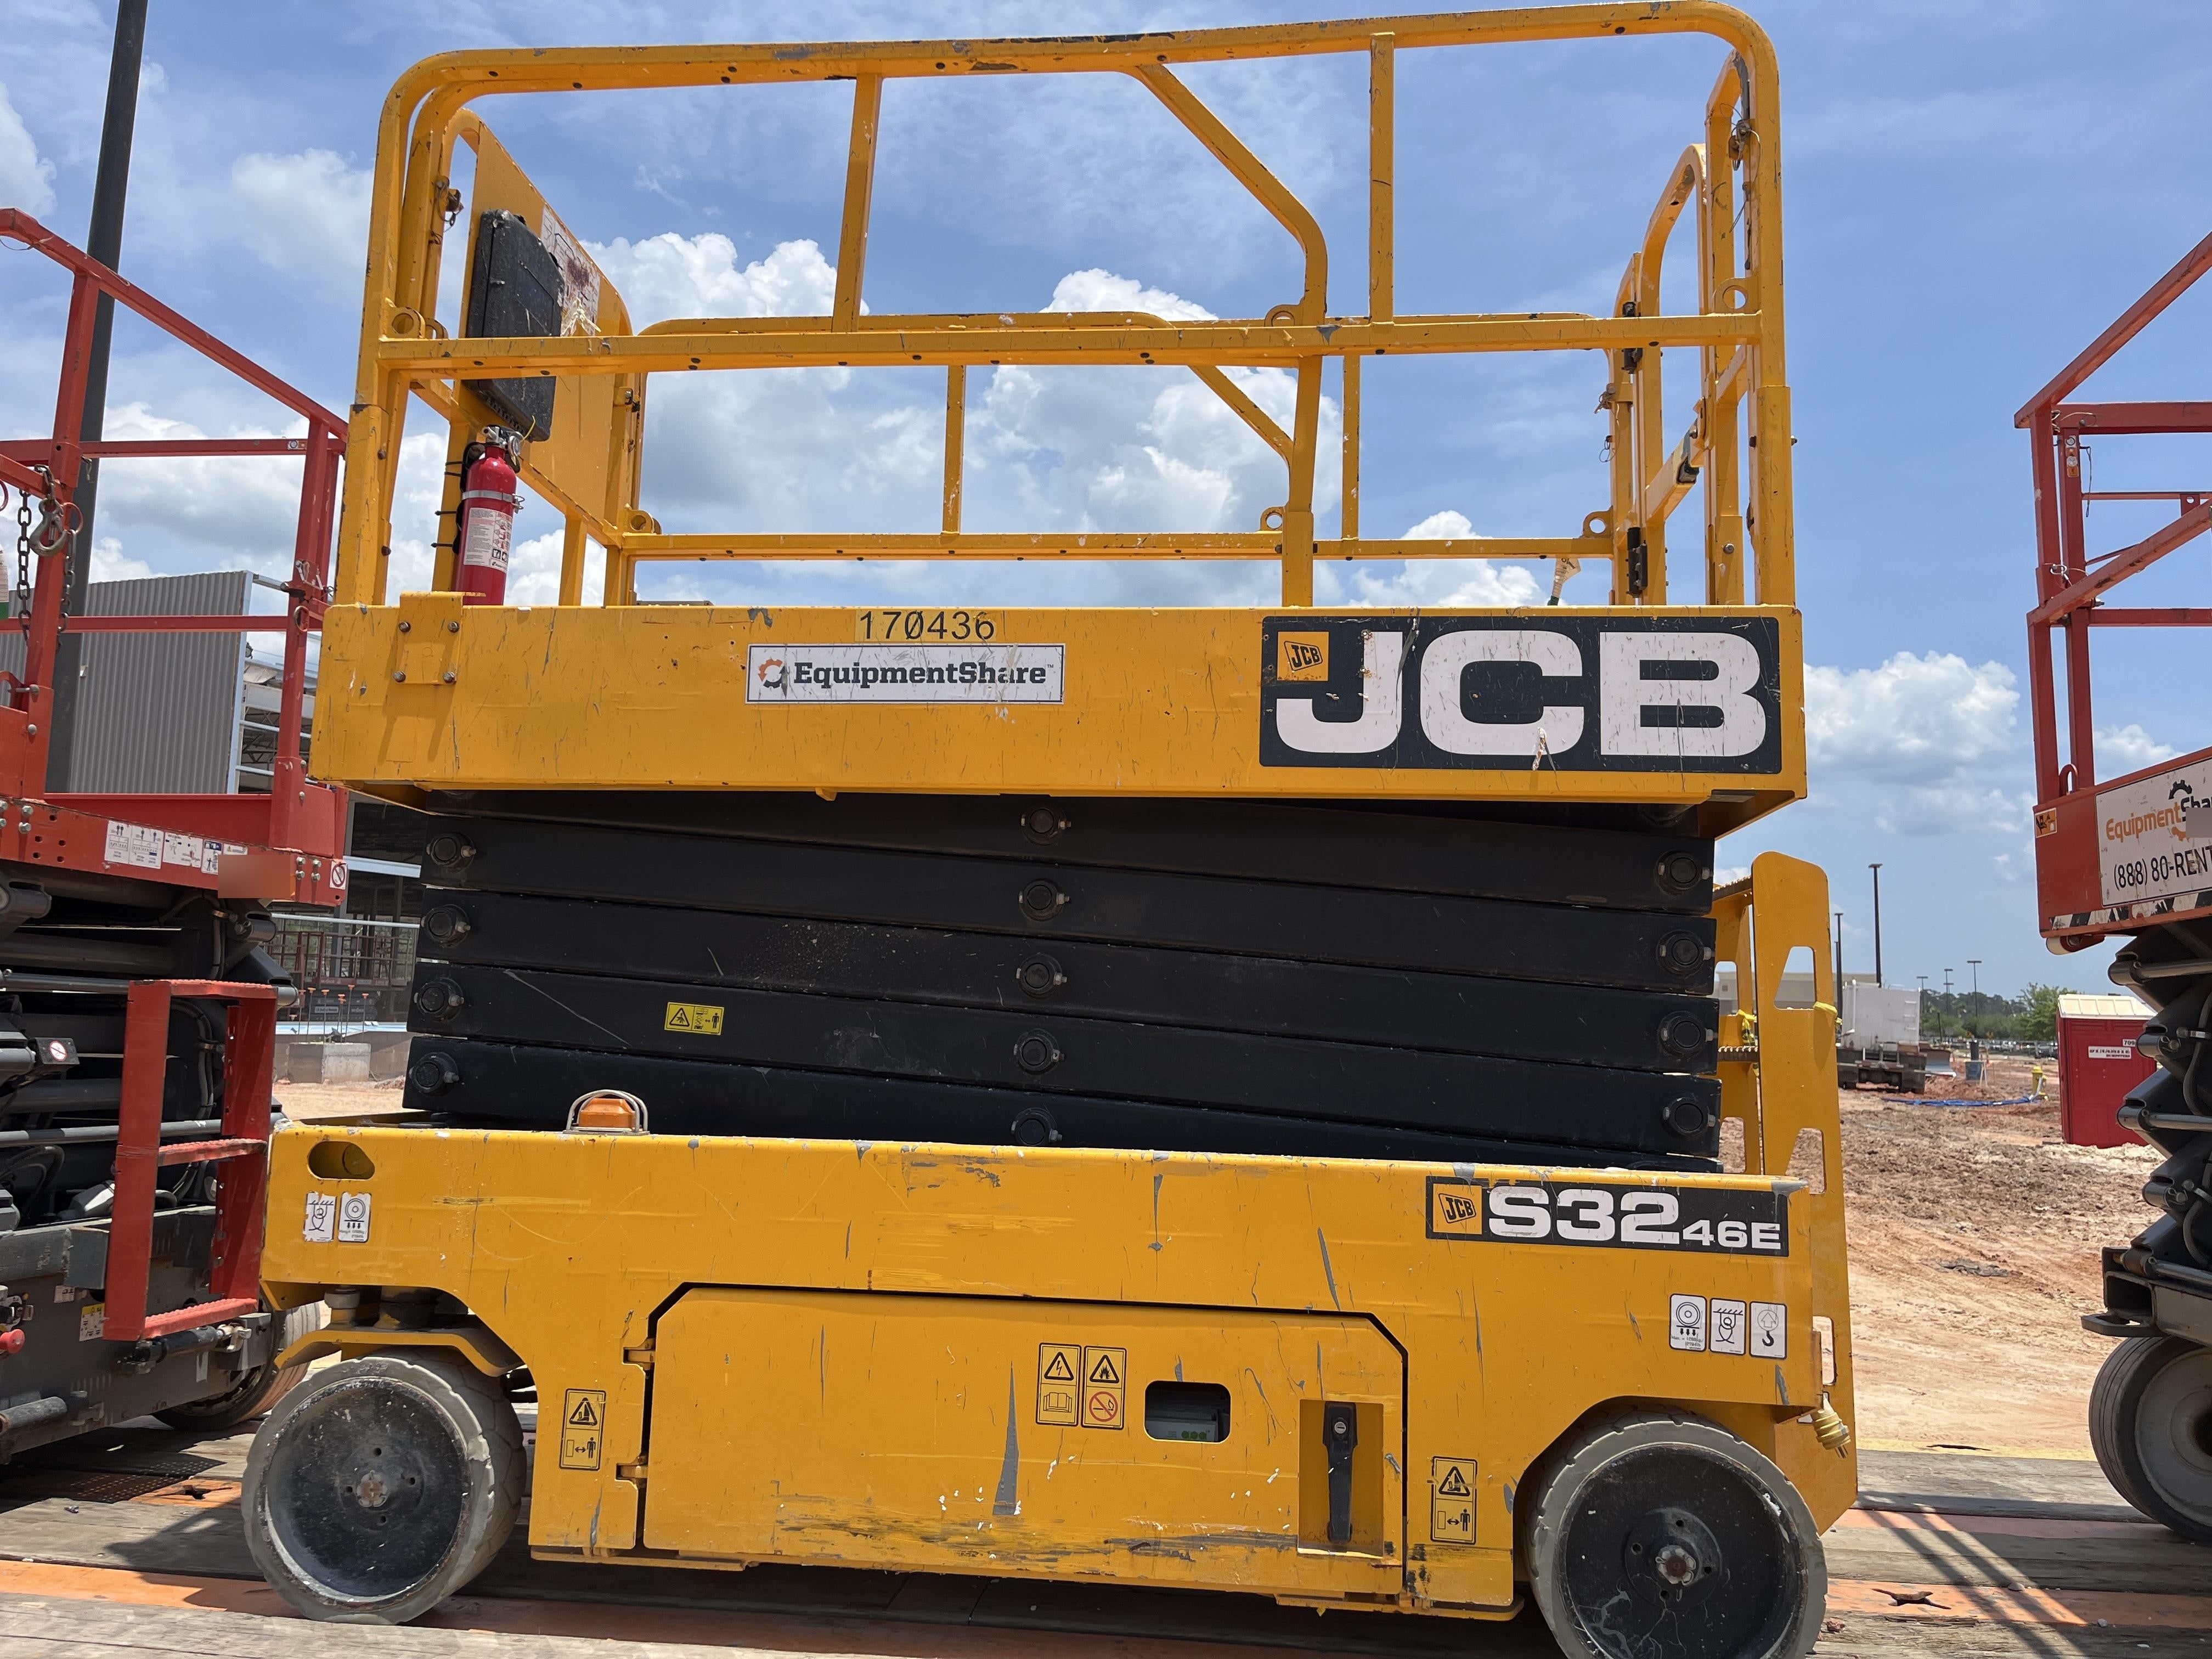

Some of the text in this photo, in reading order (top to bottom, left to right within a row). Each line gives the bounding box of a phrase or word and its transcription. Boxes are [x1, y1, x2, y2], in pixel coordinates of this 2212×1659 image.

[860, 611, 995, 640] 170436
[1291, 644, 1320, 668] JCB
[793, 662, 1046, 689] EquipmentShare
[1276, 630, 1767, 757] JCB
[2114, 857, 2147, 891] (888)
[1445, 1197, 1474, 1221] JCB
